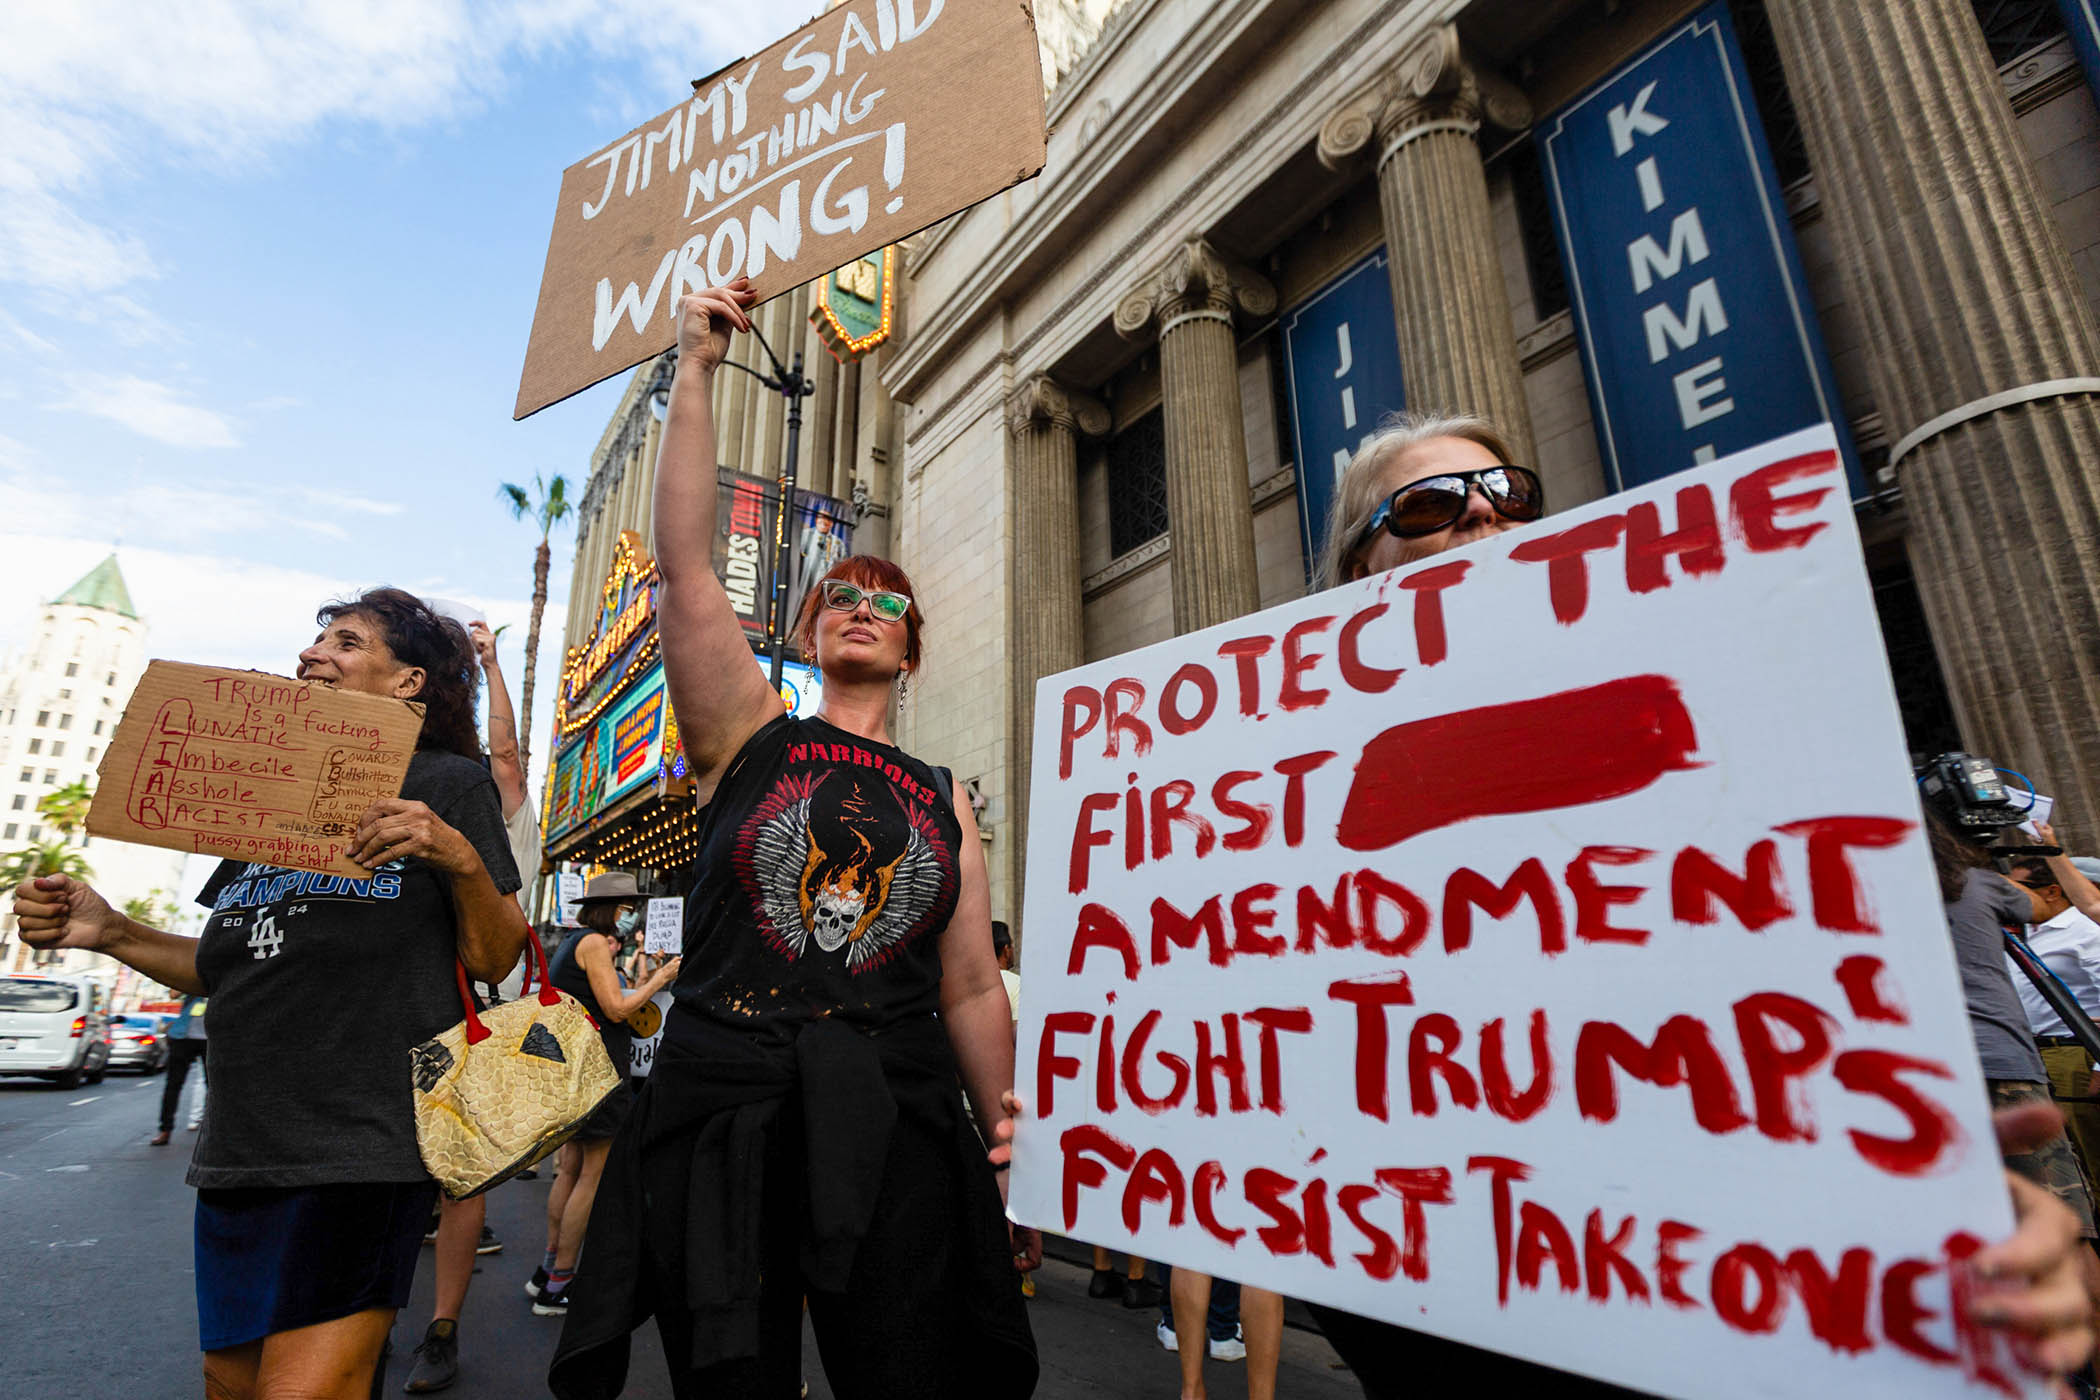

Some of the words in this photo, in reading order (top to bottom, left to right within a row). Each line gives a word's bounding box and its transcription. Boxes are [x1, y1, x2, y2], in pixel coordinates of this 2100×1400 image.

[582, 60, 759, 220] JIMMY
[783, 0, 944, 104] SAID
[683, 72, 887, 218] NOTHING
[592, 122, 906, 352] WRONG!
[1058, 560, 1474, 781] PROTECT
[1509, 448, 1838, 625] THE
[203, 678, 310, 714] TRump
[244, 702, 262, 723] is
[274, 712, 285, 727] a
[304, 710, 387, 750] fucking
[153, 740, 297, 777] Imbecile
[786, 740, 937, 807] WARRIORS
[145, 769, 257, 803] Asshole
[139, 796, 272, 828] RACIST
[1069, 749, 1339, 895] FIRST
[193, 832, 241, 854] pussy
[248, 837, 320, 858] grabbing
[272, 851, 293, 864] of
[213, 869, 401, 912] HAMPIONS
[288, 904, 309, 916] 24
[1066, 815, 1919, 980] AMENDMENT
[222, 917, 243, 927] 20
[247, 906, 284, 960] LA
[1036, 991, 1313, 1119] FIGHT
[1060, 1124, 1453, 1283] FACSIST
